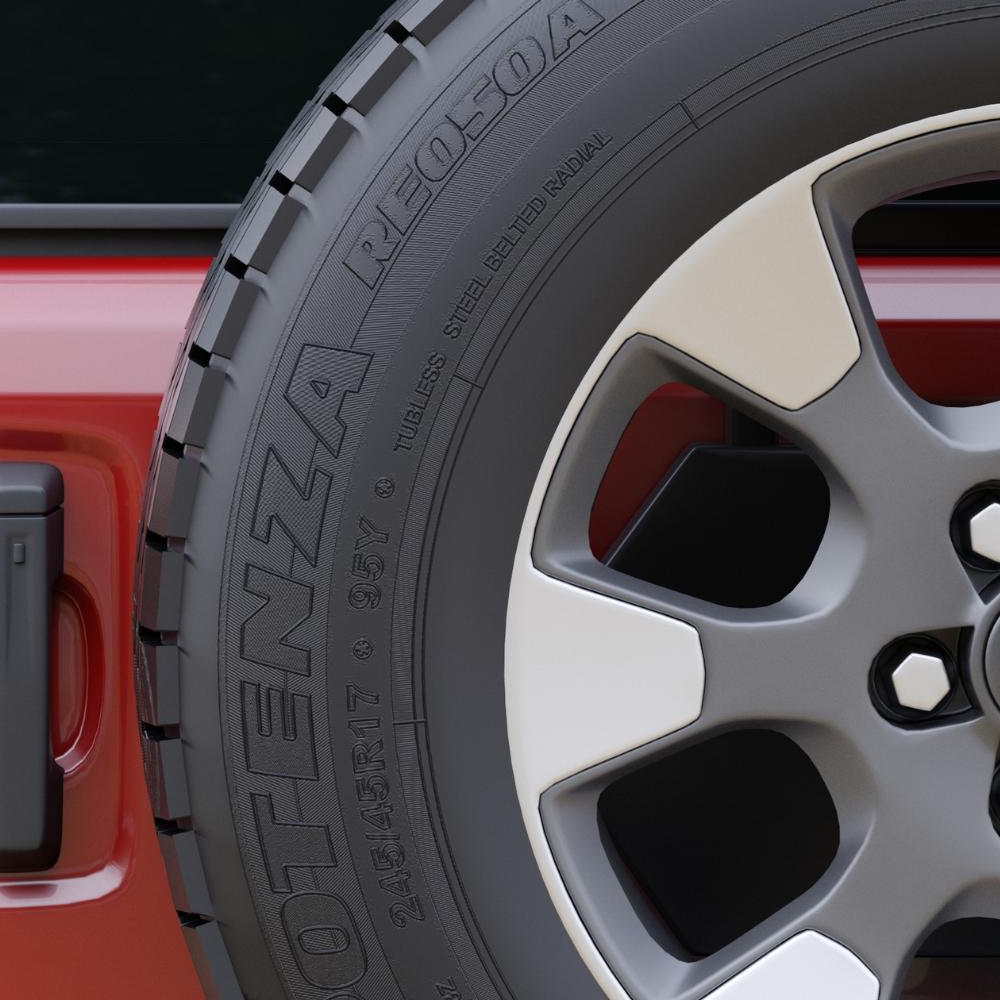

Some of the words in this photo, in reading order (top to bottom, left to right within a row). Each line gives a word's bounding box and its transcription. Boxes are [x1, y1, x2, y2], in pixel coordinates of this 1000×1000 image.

[542, 131, 614, 198] RADIAL
[483, 196, 547, 272] BELTED
[443, 275, 493, 339] STEEL
[393, 351, 447, 451] TUBLESS
[349, 516, 390, 609] 95Y
[238, 343, 375, 1000] OTENZA
[346, 682, 425, 928] 245/45R17
